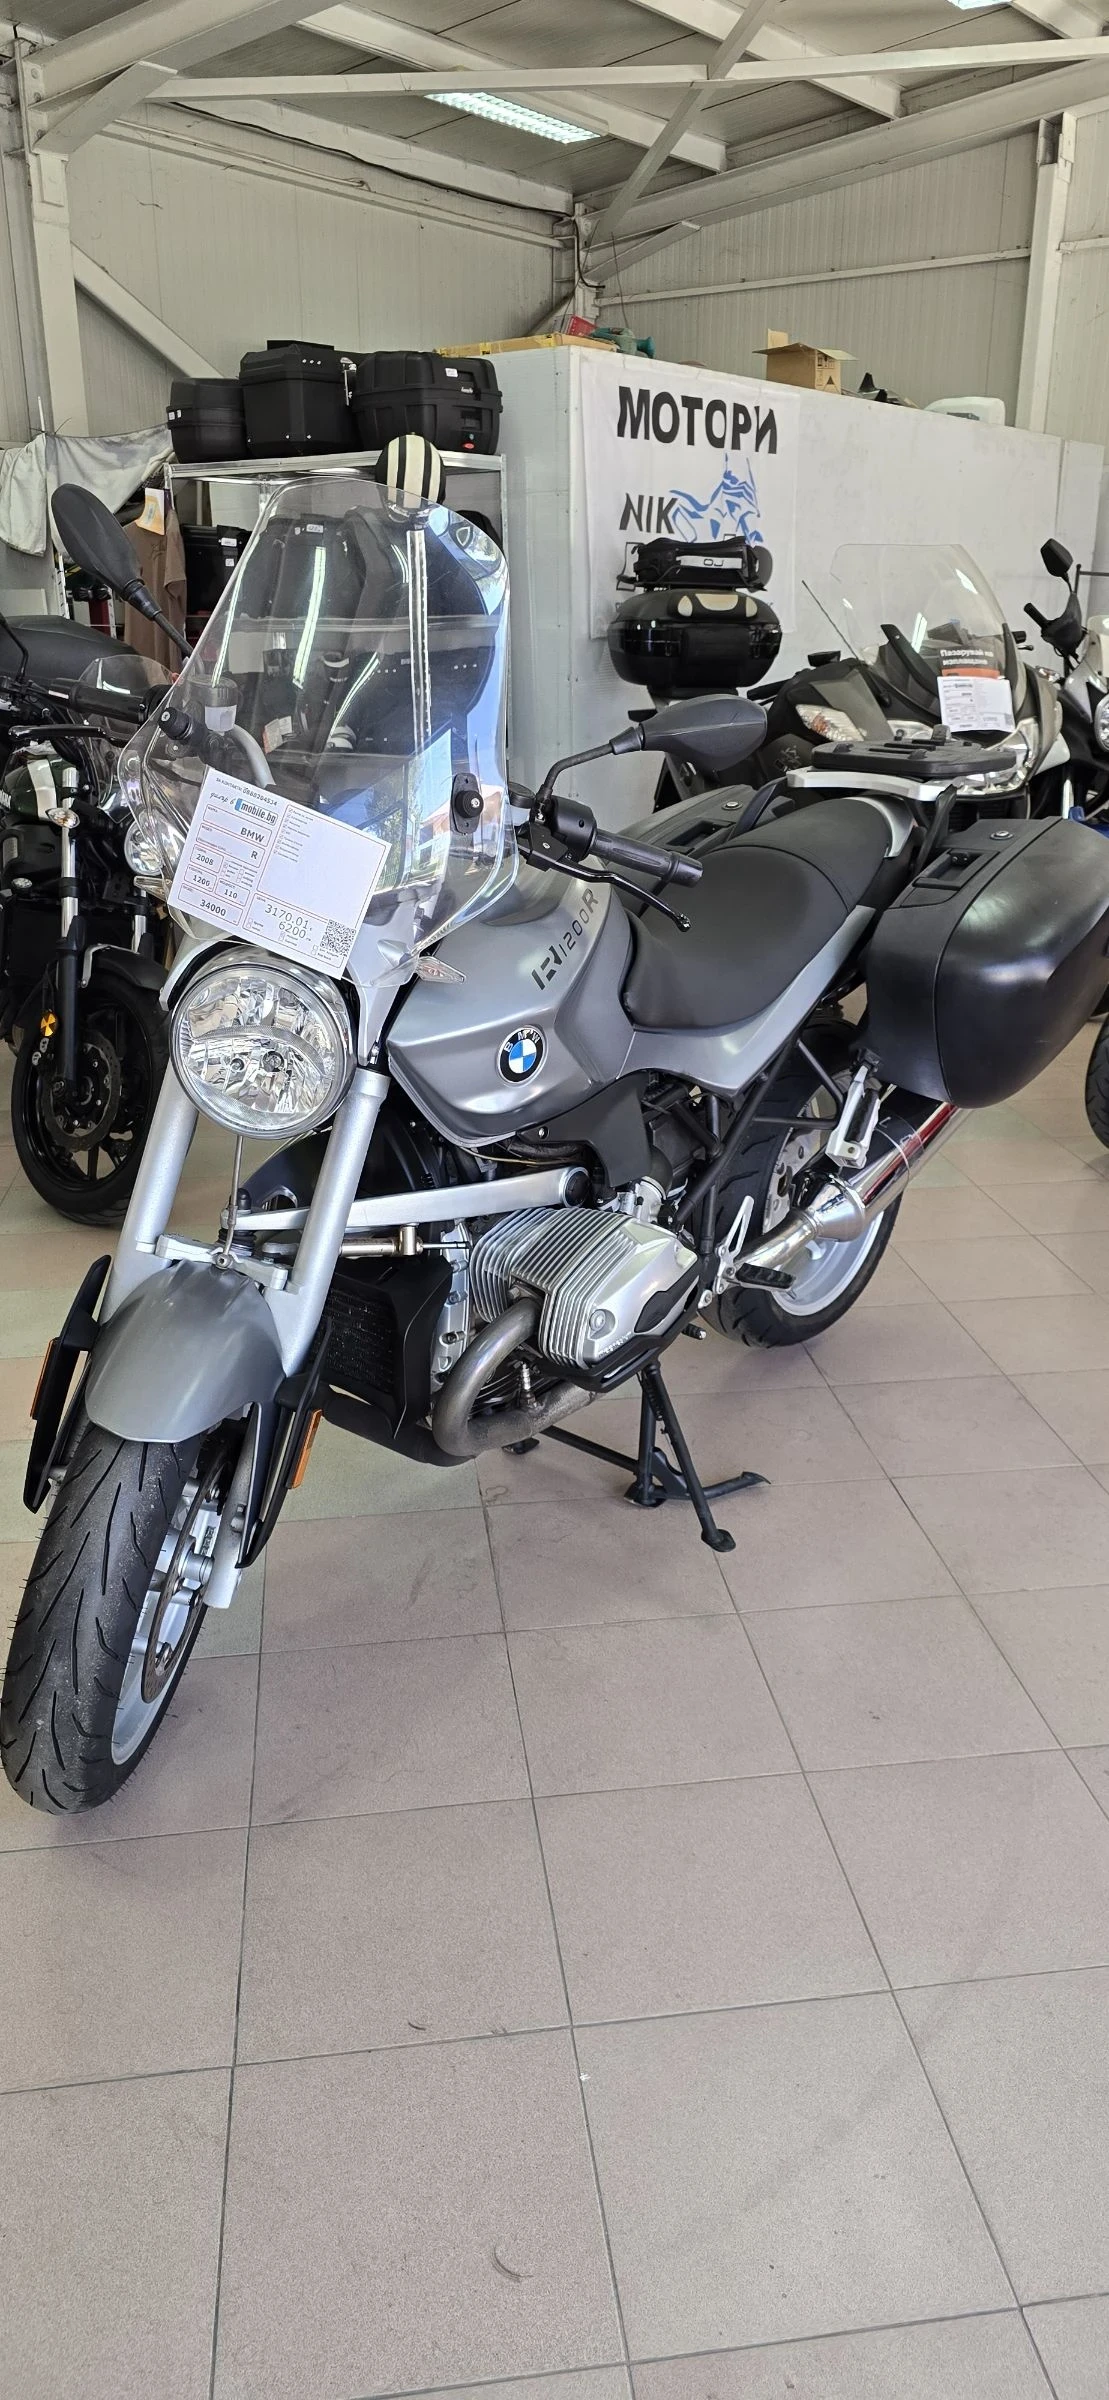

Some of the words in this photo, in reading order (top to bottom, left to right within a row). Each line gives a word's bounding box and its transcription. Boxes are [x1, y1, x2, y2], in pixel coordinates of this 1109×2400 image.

[617, 385, 778, 455] МОТОРИ
[619, 492, 678, 534] NIK
[240, 802, 277, 824] mobile.bg
[240, 827, 265, 842] BMW
[196, 853, 214, 865] 2008
[251, 850, 258, 859] R
[193, 875, 210, 888] 1200
[224, 889, 238, 899] 110
[200, 899, 226, 916] 34000
[278, 921, 306, 939] 6200
[504, 1029, 541, 1052] BMW
